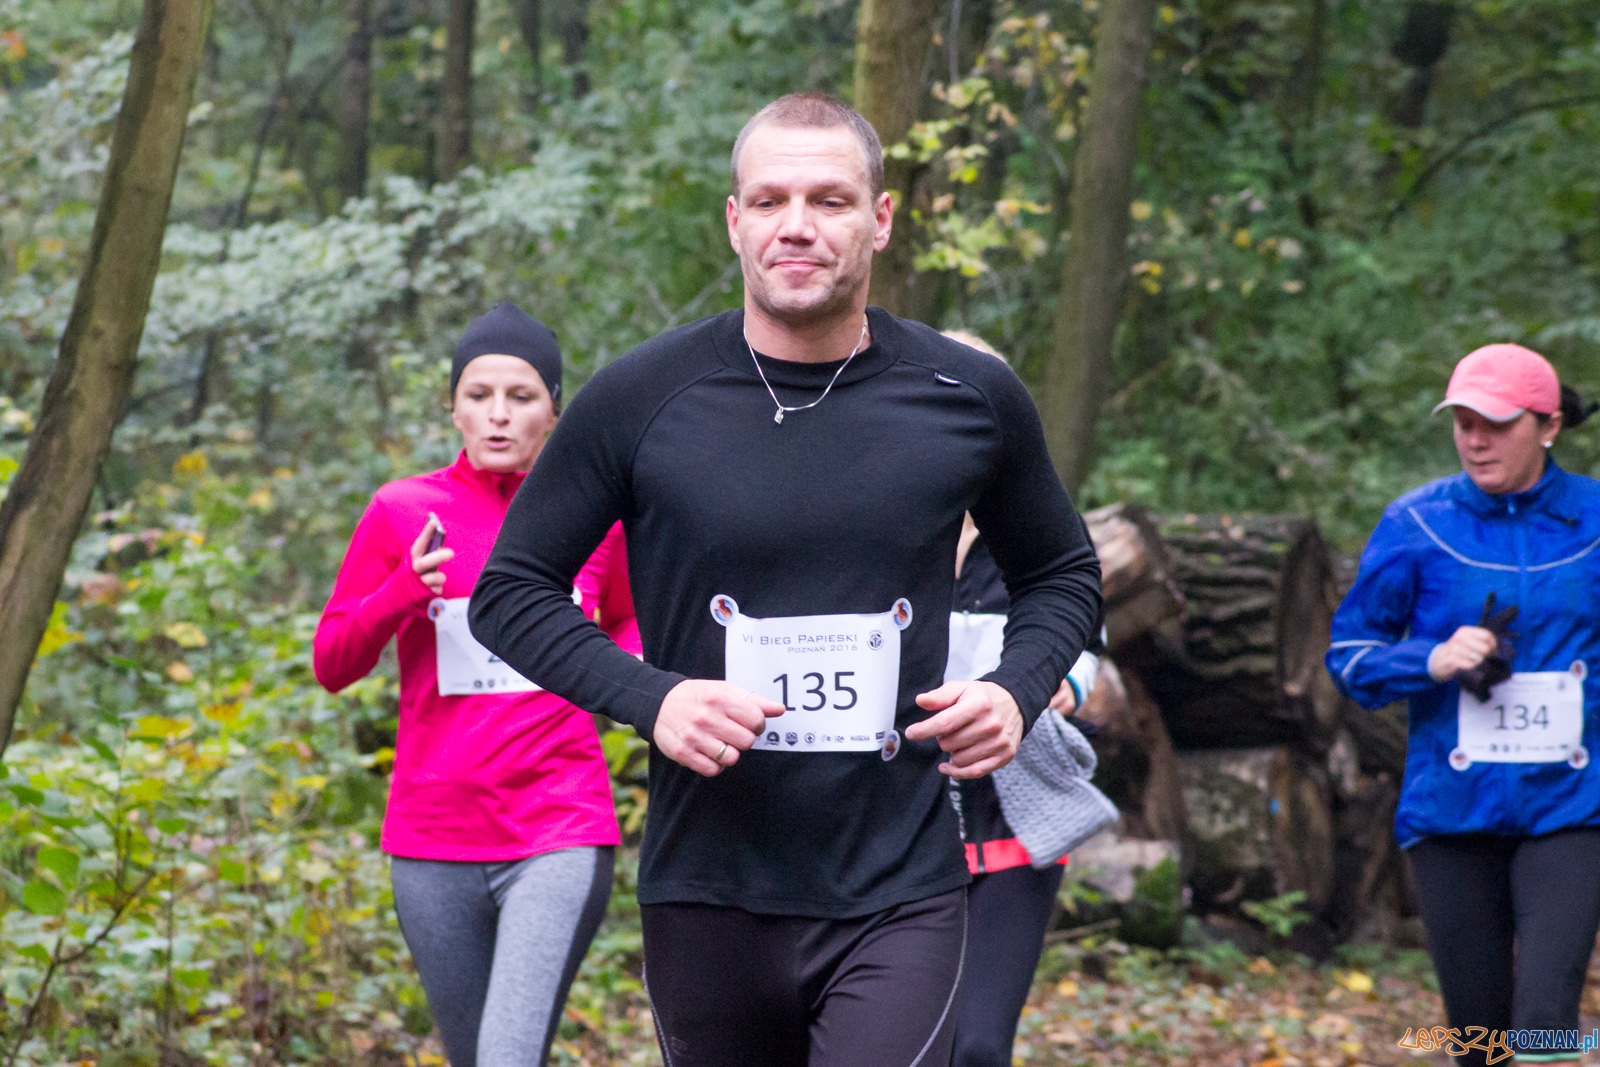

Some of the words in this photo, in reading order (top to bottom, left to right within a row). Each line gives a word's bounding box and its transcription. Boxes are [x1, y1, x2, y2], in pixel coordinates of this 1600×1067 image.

[742, 634, 753, 644] VI
[760, 635, 791, 645] BIEG
[798, 634, 858, 644] PAPIESKI
[788, 645, 826, 653] POZNAŃ
[830, 644, 858, 652] 2016
[772, 671, 858, 711] 135
[1493, 704, 1550, 731] 134
